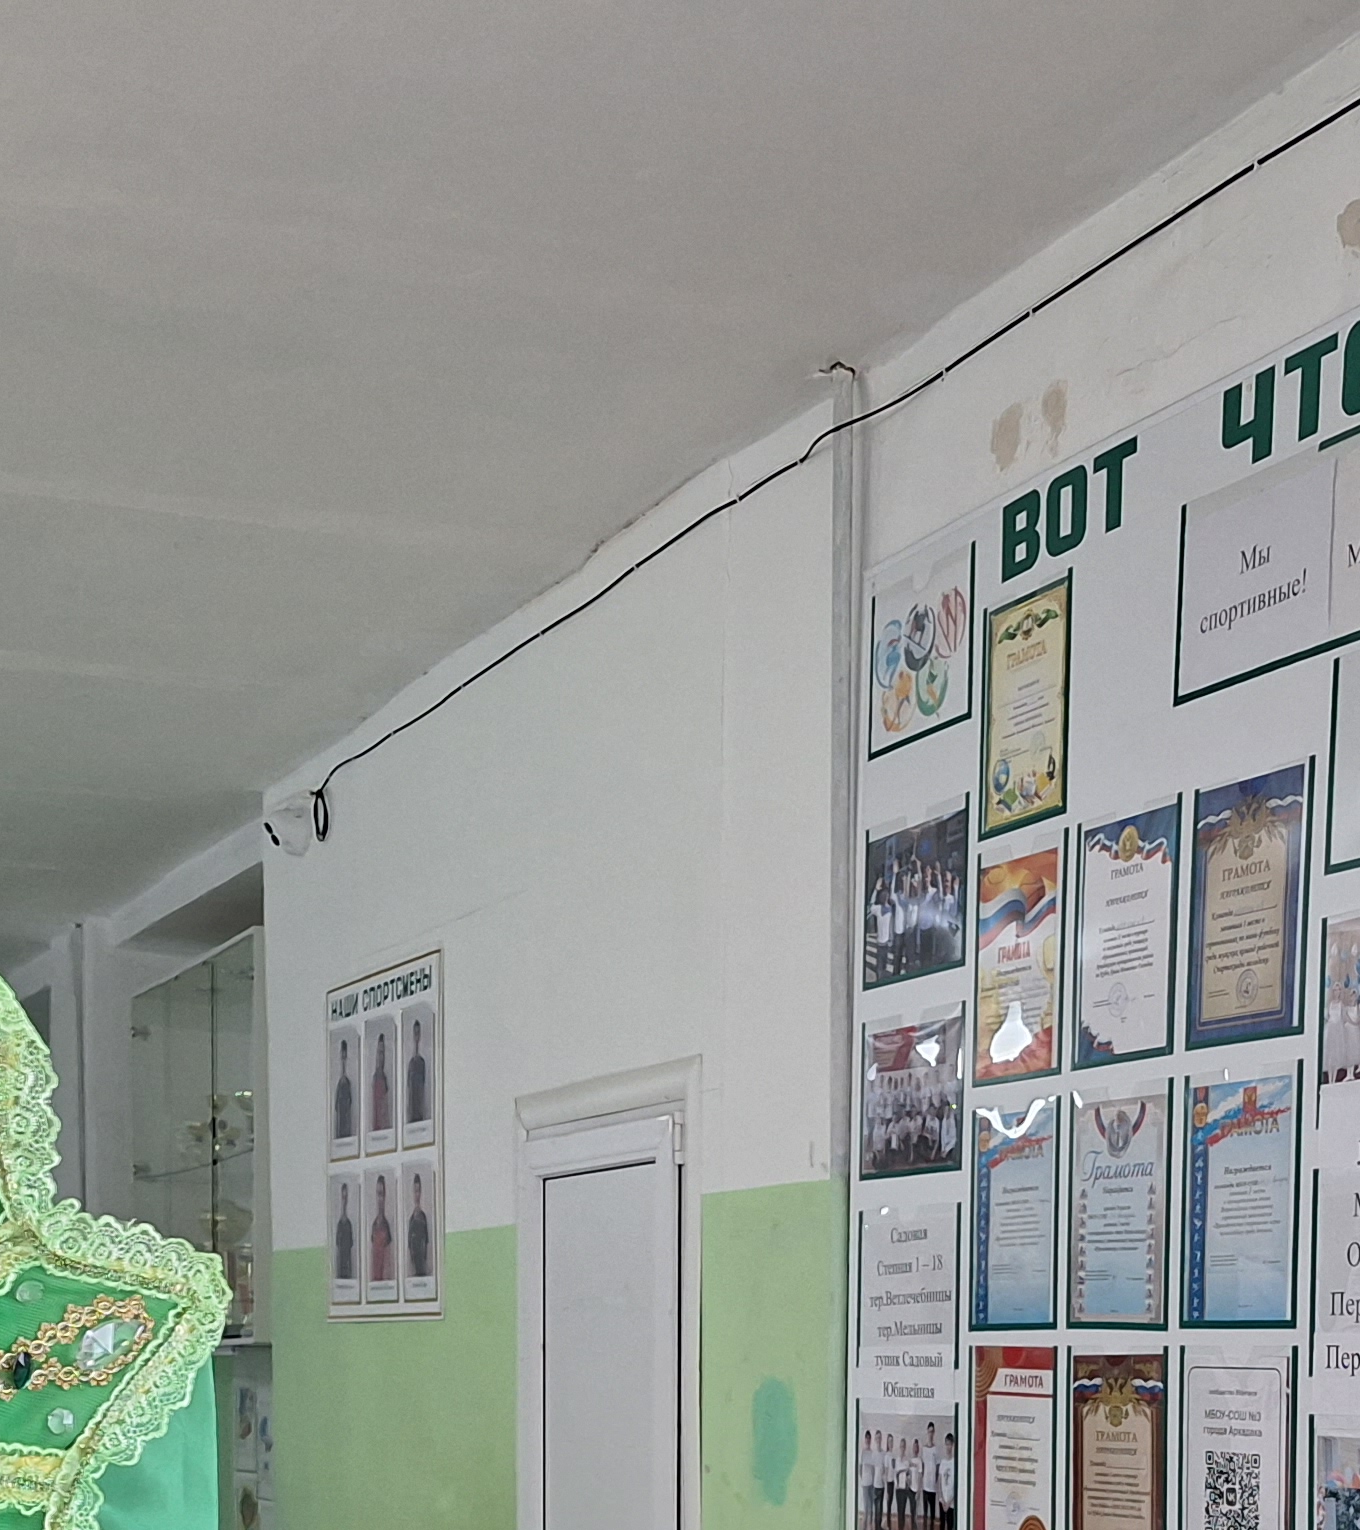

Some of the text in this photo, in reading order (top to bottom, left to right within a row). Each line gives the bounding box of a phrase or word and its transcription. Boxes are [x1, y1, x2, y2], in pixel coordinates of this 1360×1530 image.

[1001, 435, 1138, 584] ВОТ
[1239, 543, 1272, 575] Мы
[1199, 568, 1307, 634] спортивные!
[1221, 858, 1271, 883] ГРАМОТА
[330, 964, 432, 1022] НАШИ СПОРТСМЕНЫ
[1081, 1150, 1155, 1188] Грамота
[890, 1227, 928, 1243] Садовая
[932, 1254, 943, 1271] 18
[902, 1350, 943, 1368] Садовый
[883, 1381, 935, 1399] Юбилейная
[1003, 1374, 1044, 1389] ГРАМОТА
[1095, 1430, 1138, 1443] ГРАМОТА
